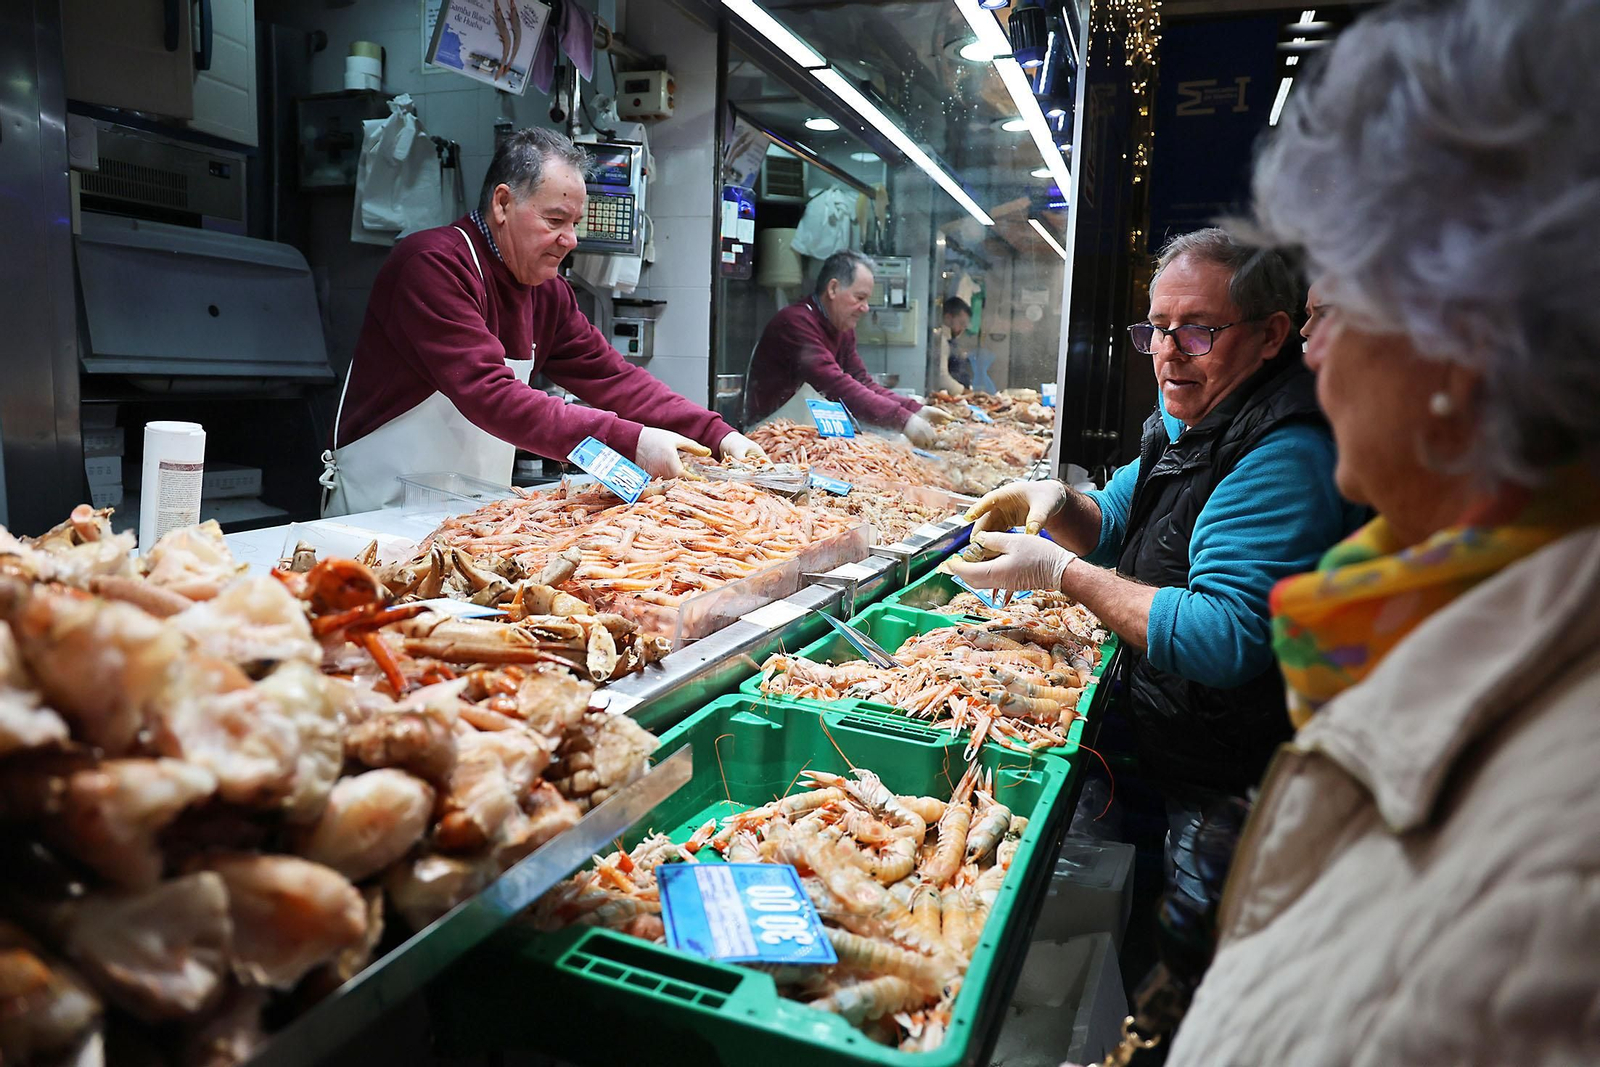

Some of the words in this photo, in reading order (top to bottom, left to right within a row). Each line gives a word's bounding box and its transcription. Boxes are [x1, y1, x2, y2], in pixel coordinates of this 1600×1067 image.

[454, 13, 463, 22] de
[463, 16, 483, 31] Huelva
[471, 11, 491, 25] Blanca
